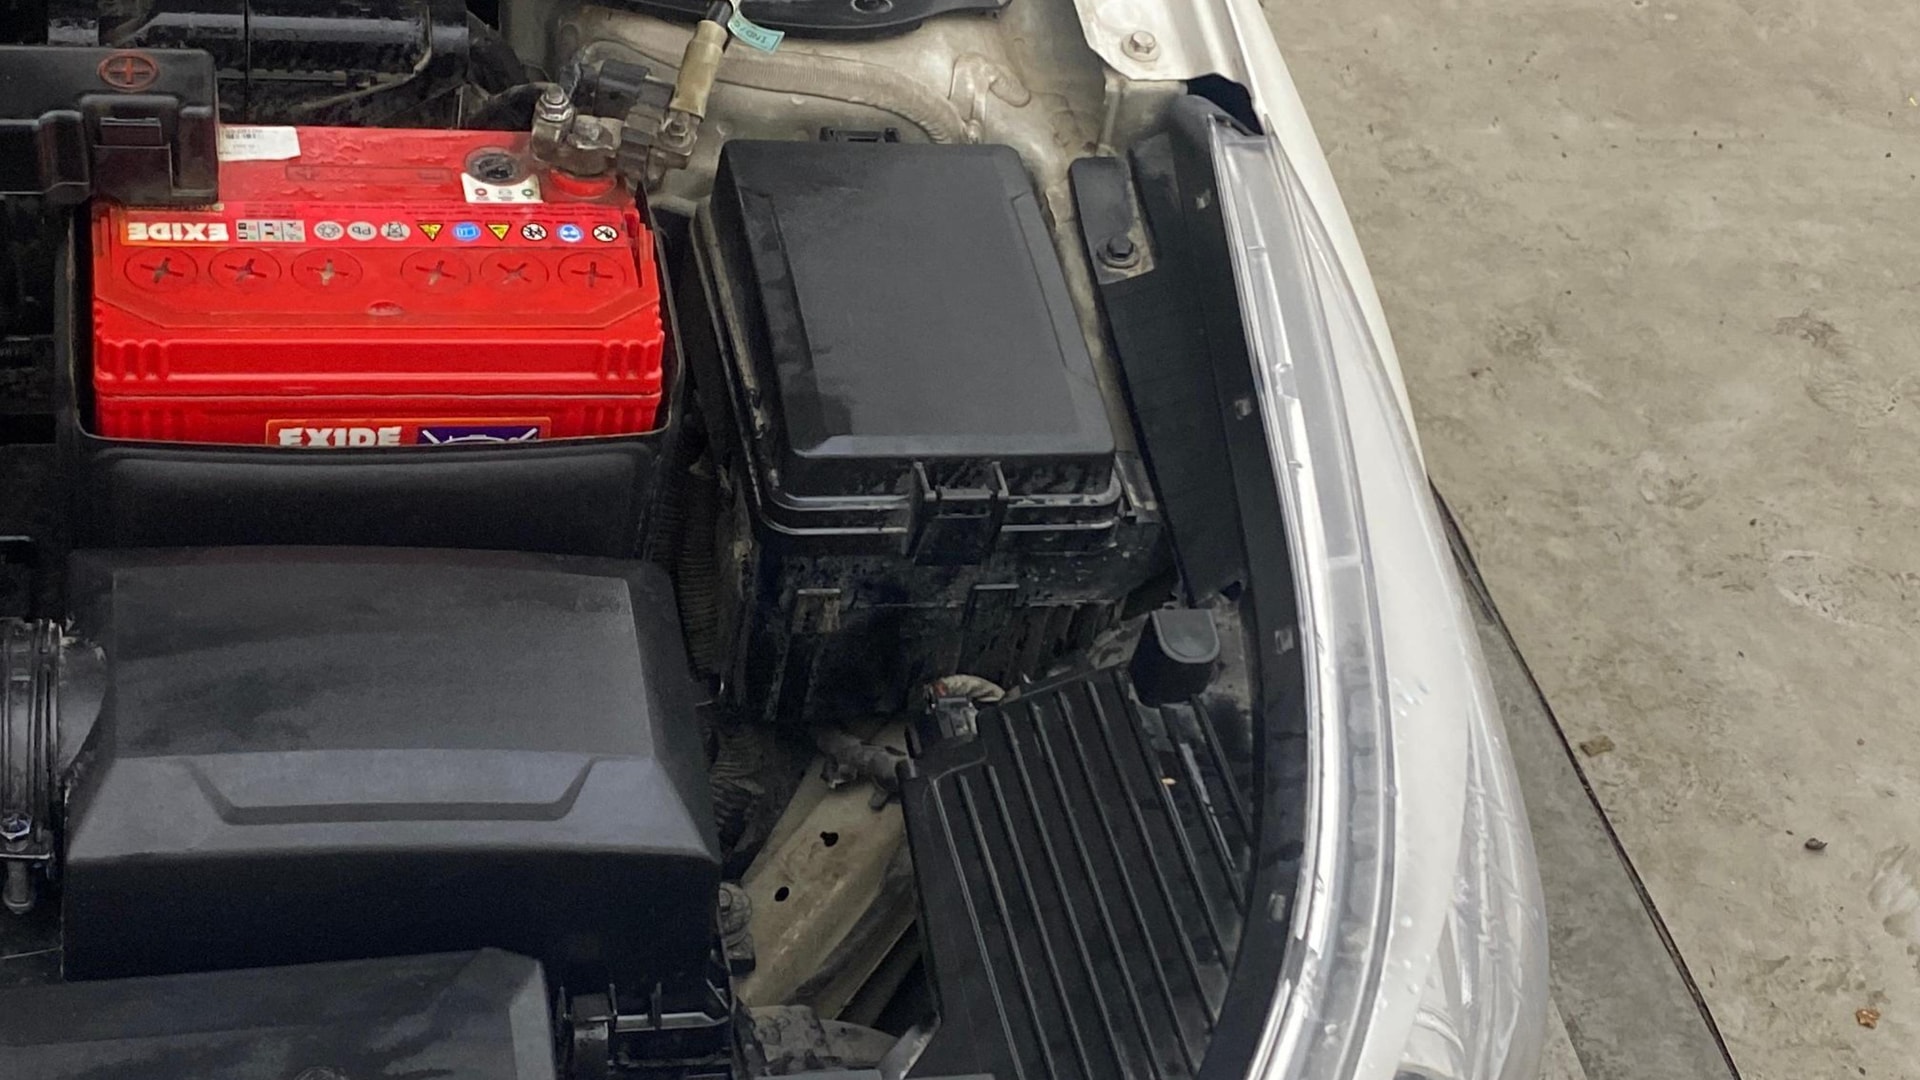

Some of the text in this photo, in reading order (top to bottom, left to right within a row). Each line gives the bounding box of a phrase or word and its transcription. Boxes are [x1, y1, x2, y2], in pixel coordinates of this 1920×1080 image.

[128, 222, 229, 242] EXIDE
[352, 225, 371, 237] Pb
[279, 426, 402, 447] EXIDE
